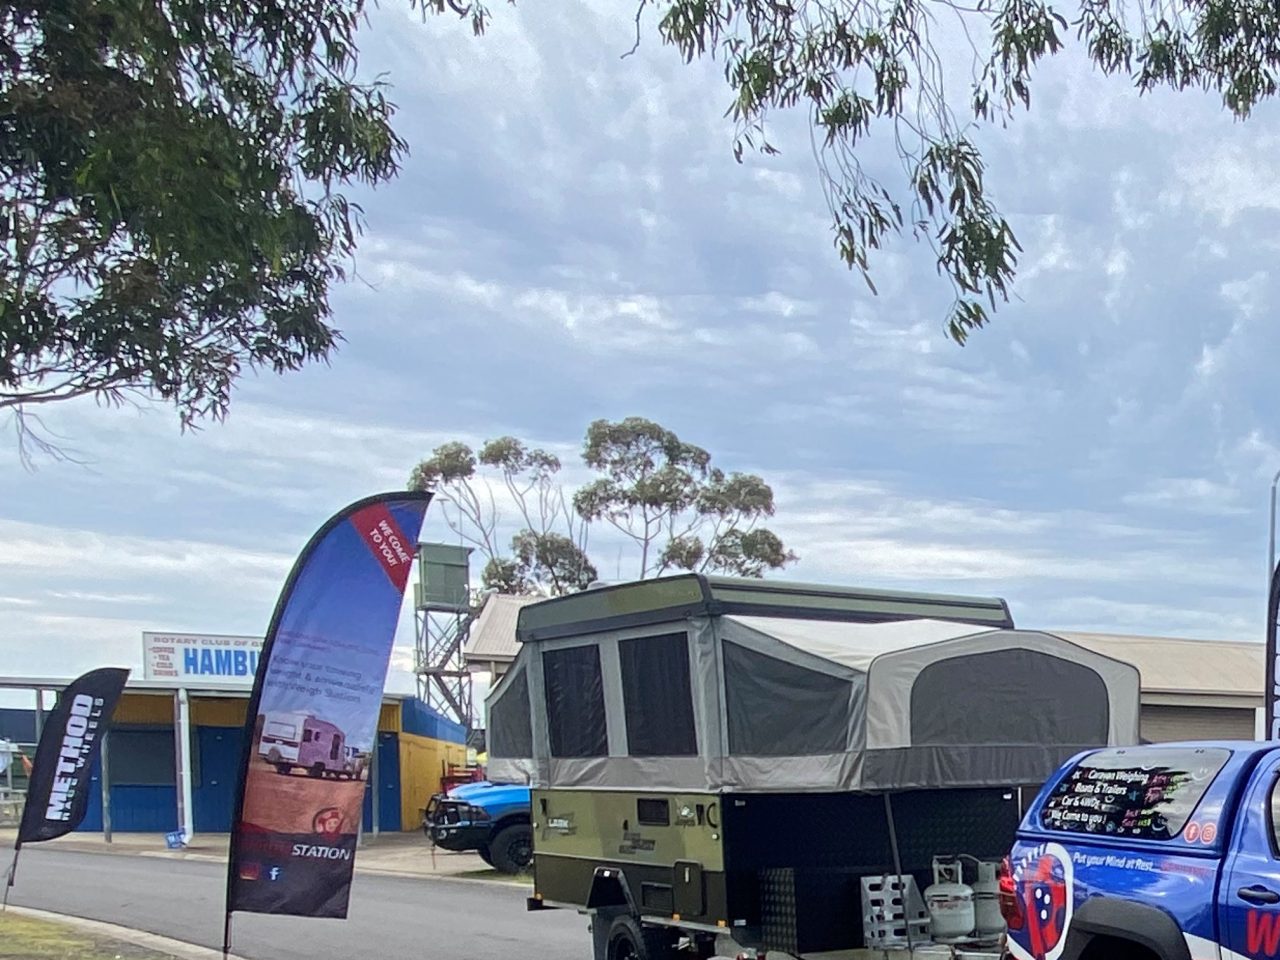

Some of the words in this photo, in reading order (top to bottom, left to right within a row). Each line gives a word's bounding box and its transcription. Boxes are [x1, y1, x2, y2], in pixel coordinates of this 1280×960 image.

[370, 528, 382, 543] TO
[379, 520, 393, 537] WE
[388, 535, 411, 563] COME
[45, 693, 93, 821] METHOD
[1073, 851, 1086, 864] Put
[1086, 854, 1105, 867] your
[1105, 854, 1126, 869] Mind
[1126, 859, 1135, 869] at
